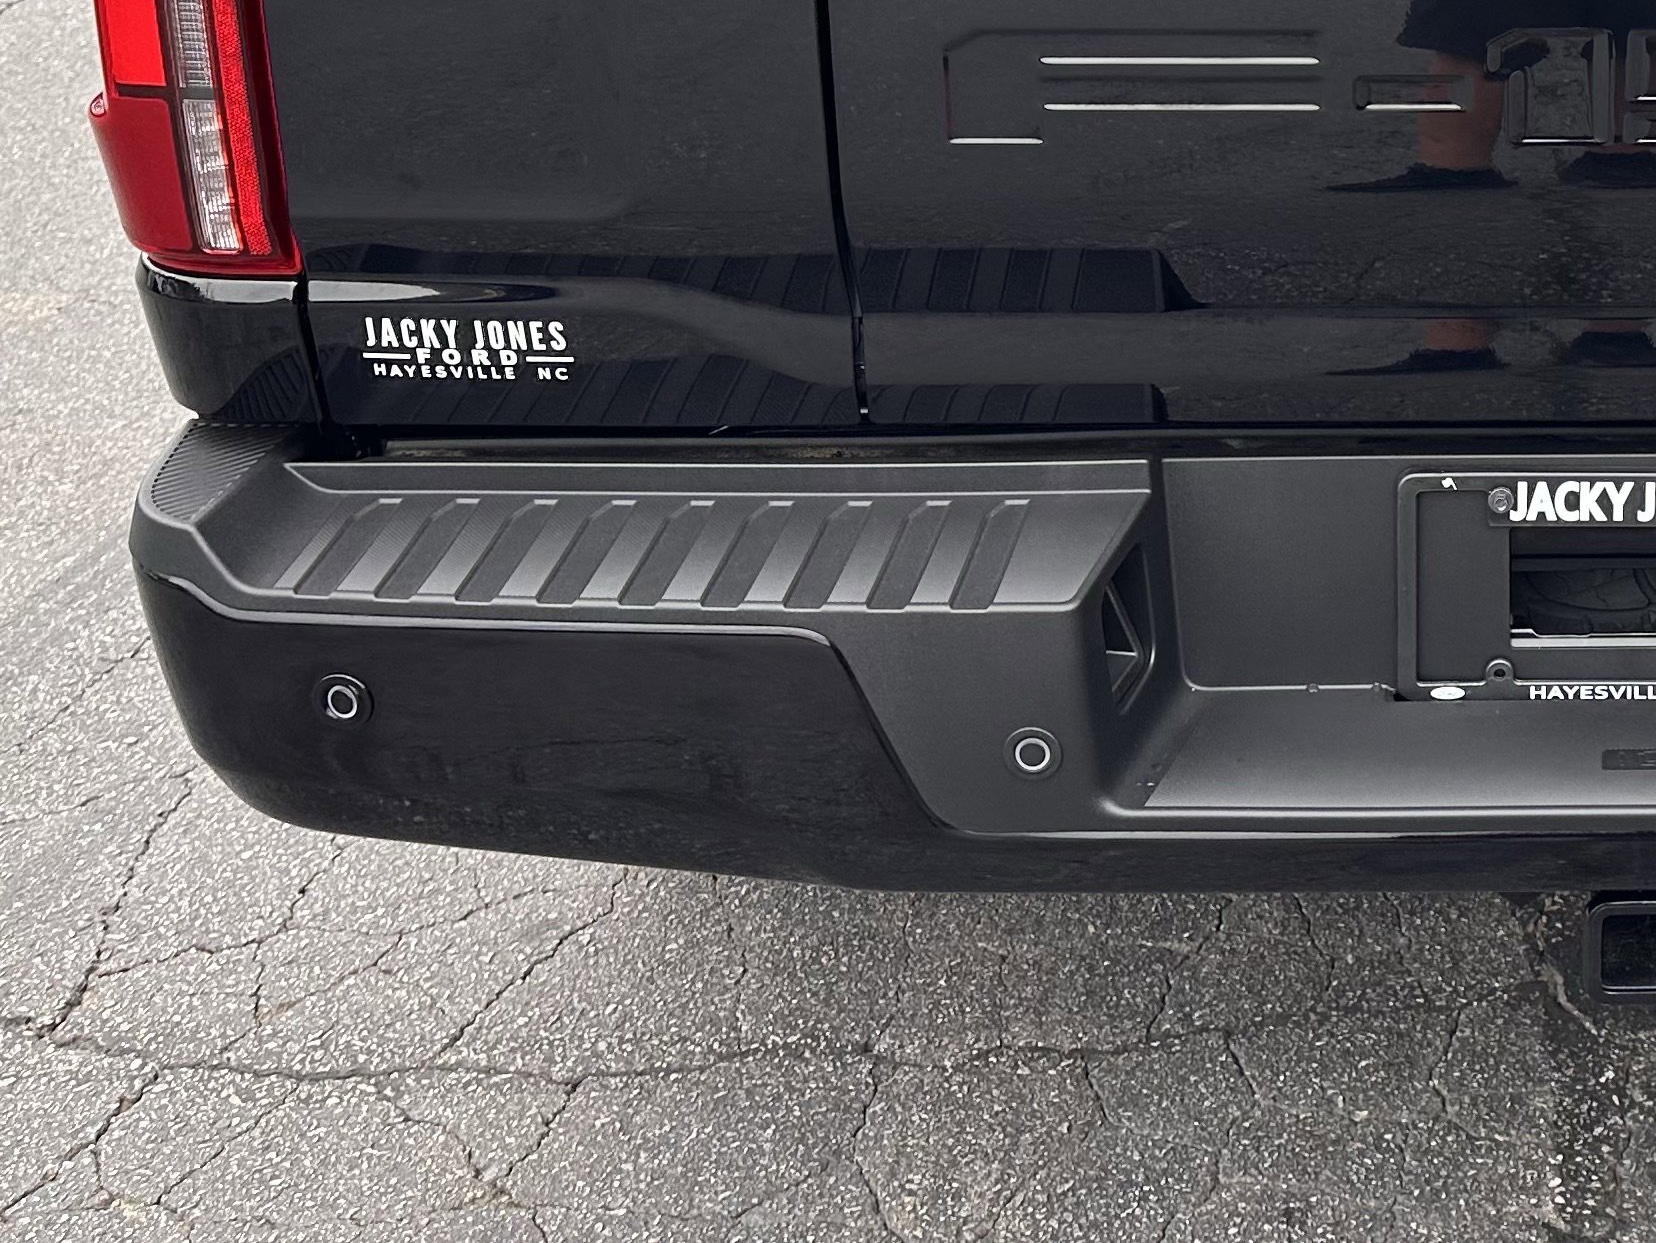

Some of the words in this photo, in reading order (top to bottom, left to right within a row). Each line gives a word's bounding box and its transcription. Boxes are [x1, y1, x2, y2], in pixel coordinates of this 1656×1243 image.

[365, 316, 457, 350] JACKY
[473, 319, 567, 352] JONES
[415, 347, 518, 366] FORD
[373, 362, 517, 380] HAYESVILLE
[537, 367, 569, 381] NC
[1509, 480, 1635, 522] JACKY
